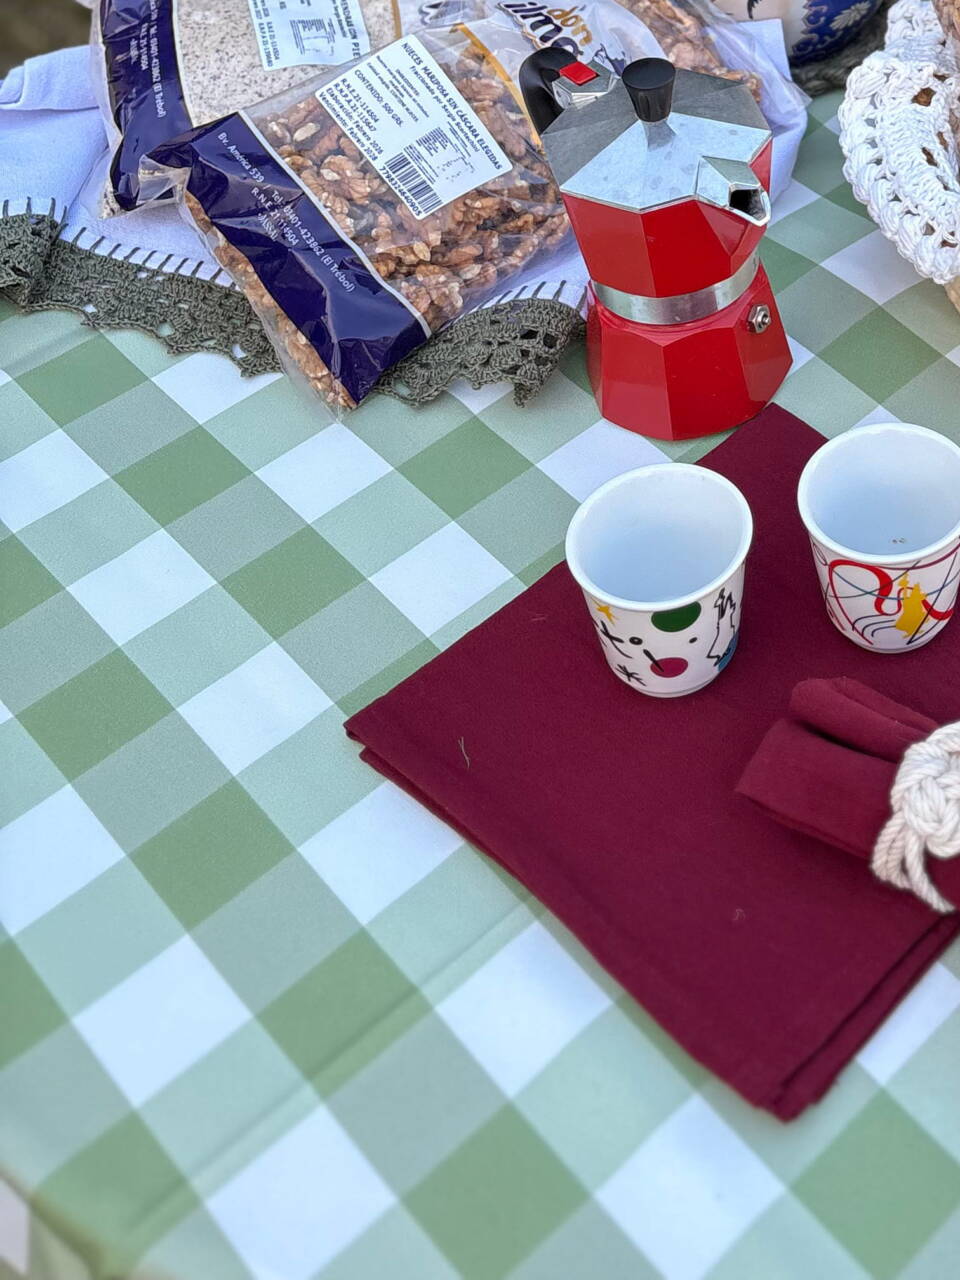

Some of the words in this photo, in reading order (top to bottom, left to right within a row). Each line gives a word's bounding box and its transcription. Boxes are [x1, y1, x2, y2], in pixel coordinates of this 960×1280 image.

[350, 42, 363, 60] PIE
[547, 4, 593, 47] don
[353, 68, 385, 104] CONTENIDO:
[381, 102, 394, 115] 500
[390, 112, 405, 127] GRS.
[401, 41, 424, 66] NUECES
[420, 64, 450, 98] MARIPOSA
[445, 96, 459, 110] SIN
[453, 107, 482, 139] CÁSCARA
[474, 137, 504, 170] ELEGIDAS
[409, 65, 436, 96] Fraccionado
[432, 94, 444, 105] por
[317, 91, 350, 128] Vencimiento:
[346, 126, 367, 148] Febrero
[363, 146, 378, 161] 2028
[324, 87, 355, 121] Elaboración:
[352, 120, 372, 142] Febrero
[369, 140, 384, 155] 2026
[217, 131, 230, 145] Bv.
[227, 142, 253, 171] América
[248, 167, 265, 184] 539
[279, 204, 325, 257] 03401-423862
[319, 252, 334, 267] (El
[328, 263, 356, 294] Trébol)
[267, 207, 301, 245] 21-114504
